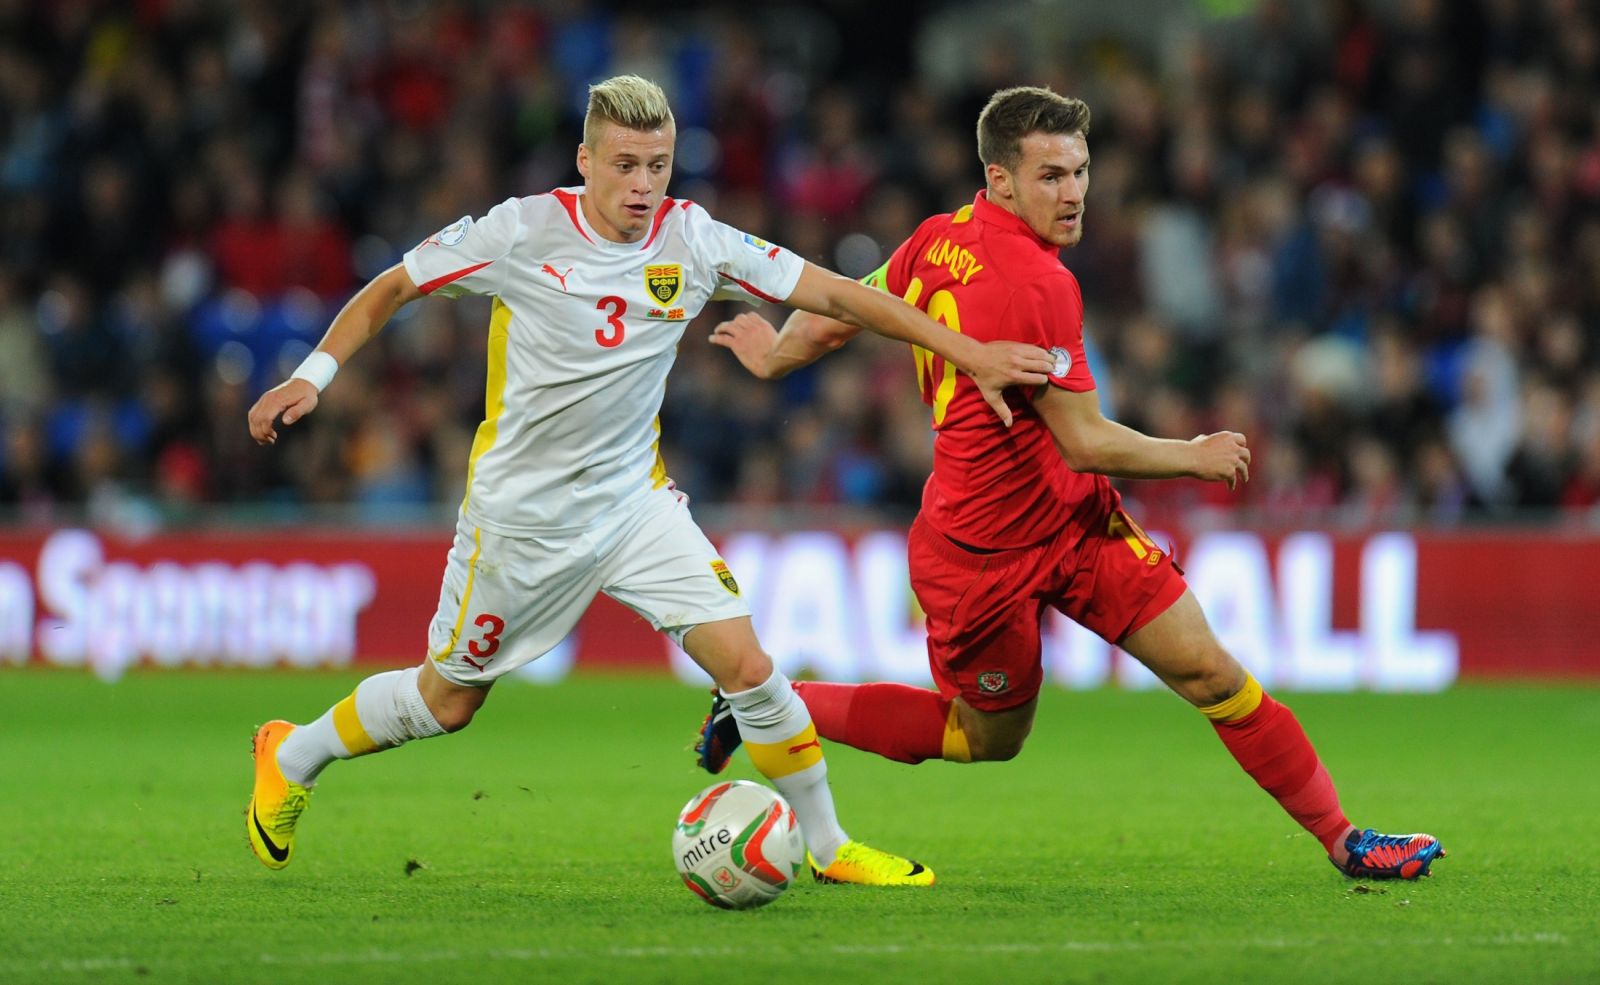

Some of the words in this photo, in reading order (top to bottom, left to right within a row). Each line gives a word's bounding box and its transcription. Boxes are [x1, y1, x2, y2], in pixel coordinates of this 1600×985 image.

[594, 295, 628, 348] 3
[468, 613, 505, 658] 3
[682, 828, 732, 870] mitre
